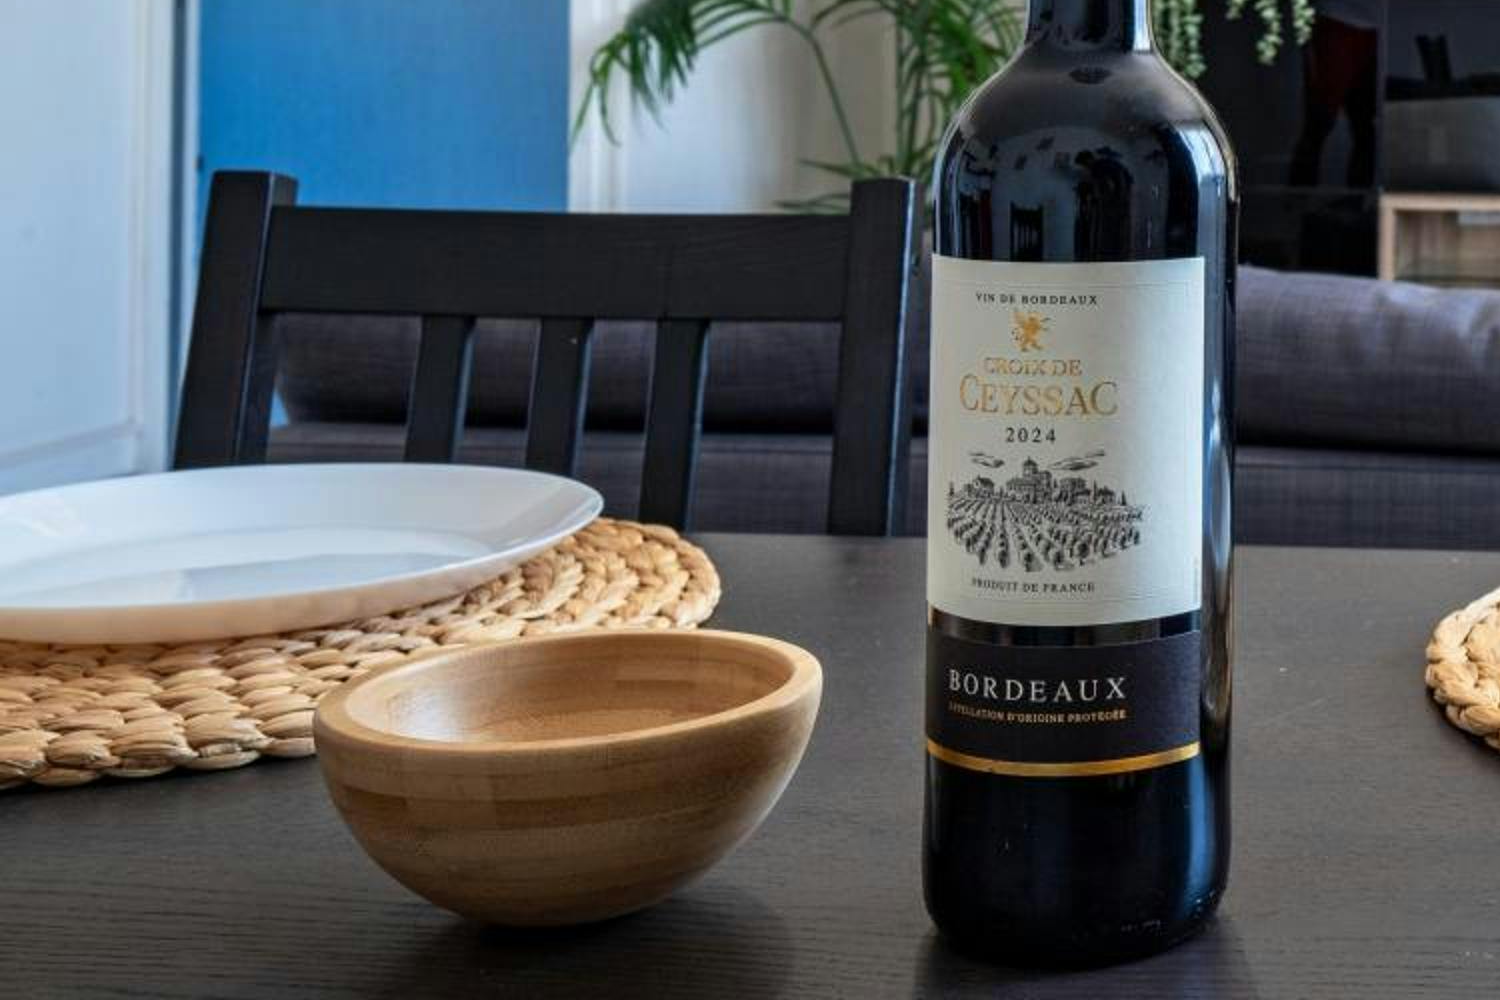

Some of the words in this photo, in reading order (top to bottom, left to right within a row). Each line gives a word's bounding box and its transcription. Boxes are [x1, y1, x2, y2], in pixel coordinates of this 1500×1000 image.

[975, 293, 996, 303] VIN
[999, 294, 1016, 304] DE
[1021, 295, 1097, 305] BORDEAUX
[984, 357, 1047, 375] CROIX
[1052, 359, 1083, 376] DE
[959, 373, 1119, 416] CEYSSAC
[1005, 427, 1056, 443] 2024
[1023, 583, 1039, 593] DE
[1043, 582, 1095, 593] FRANCE
[949, 669, 1127, 702] BORDEAUX
